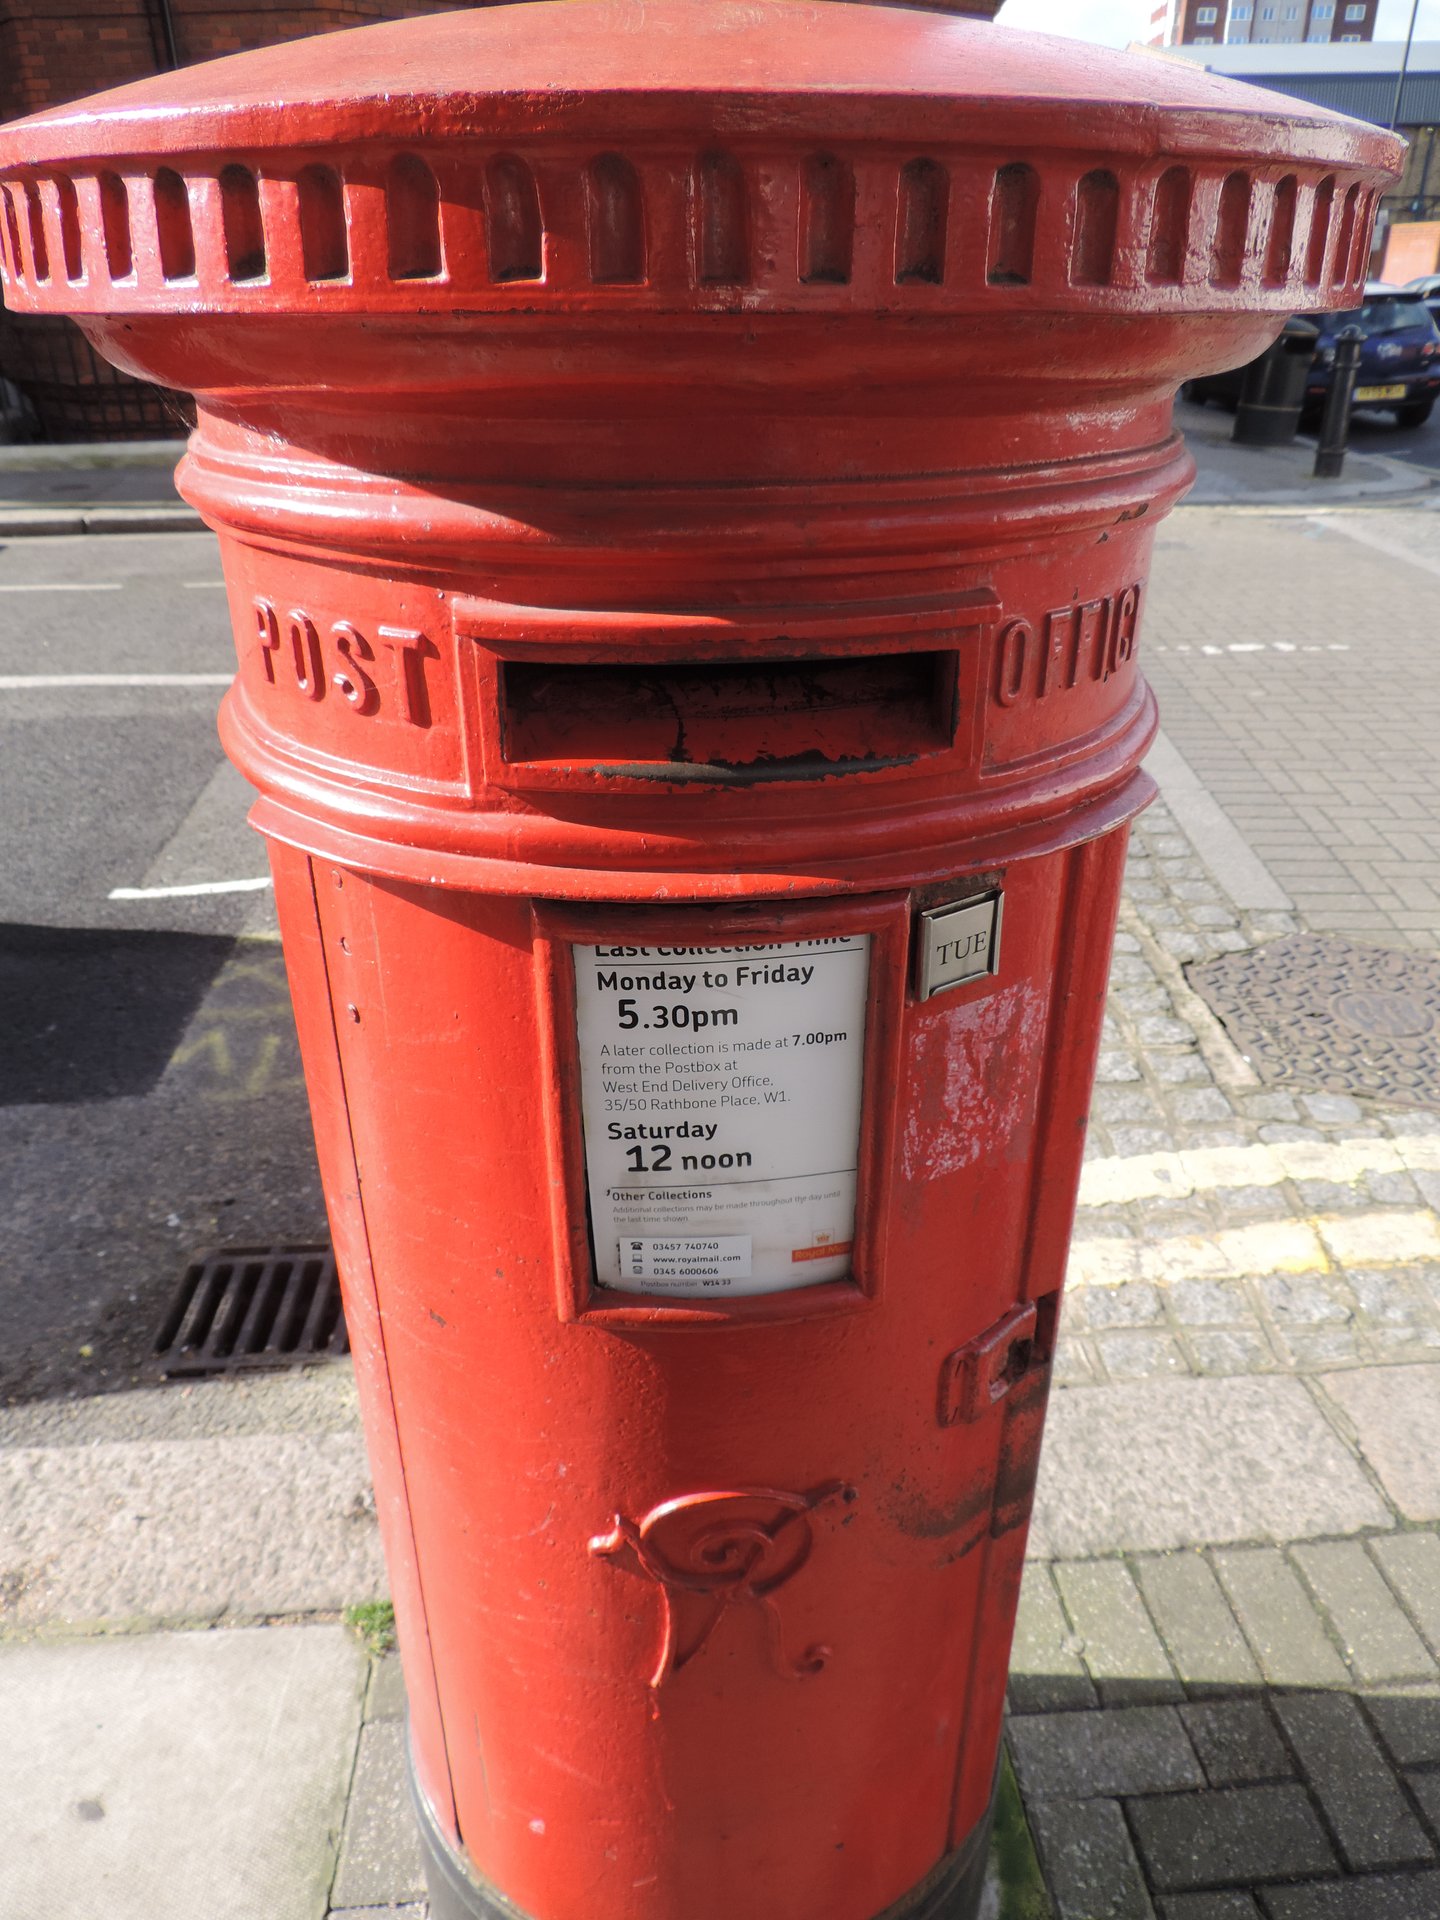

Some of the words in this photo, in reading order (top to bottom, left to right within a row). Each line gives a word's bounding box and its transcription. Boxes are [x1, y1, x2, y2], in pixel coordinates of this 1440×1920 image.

[252, 596, 441, 729] POST
[936, 930, 987, 966] TUE
[596, 970, 697, 994] Monday
[702, 971, 729, 989] to
[736, 964, 815, 987] Friday
[618, 999, 738, 1033] 5.30pm
[600, 1044, 611, 1056] A
[613, 1043, 645, 1057] later
[649, 1043, 715, 1056] collection
[718, 1041, 729, 1054] is
[733, 1038, 772, 1053] made
[774, 1037, 789, 1049] at
[792, 1031, 848, 1047] 7.00pm
[601, 1062, 636, 1075] from
[638, 1062, 662, 1075] the
[665, 1060, 722, 1074] Postbox
[724, 1060, 738, 1071] at
[602, 1080, 639, 1094] West
[642, 1080, 669, 1093] End
[672, 1079, 729, 1093] Delivery
[731, 1075, 775, 1089] Office.
[604, 1098, 648, 1113] 35/50
[650, 1098, 717, 1111] Rathbone
[607, 1120, 718, 1141] Saturday
[625, 1144, 673, 1172] 12
[681, 1151, 753, 1171] noon
[612, 1206, 651, 1214] Additional
[653, 1204, 694, 1213] collections
[696, 1203, 714, 1212] may
[726, 1202, 749, 1210] made
[750, 1196, 793, 1208] throughout
[648, 1190, 713, 1201] Collections
[684, 1242, 719, 1250] 740740
[652, 1255, 741, 1264] www.royalmail.com
[653, 1267, 676, 1275] 0345
[679, 1267, 719, 1275] 6000606
